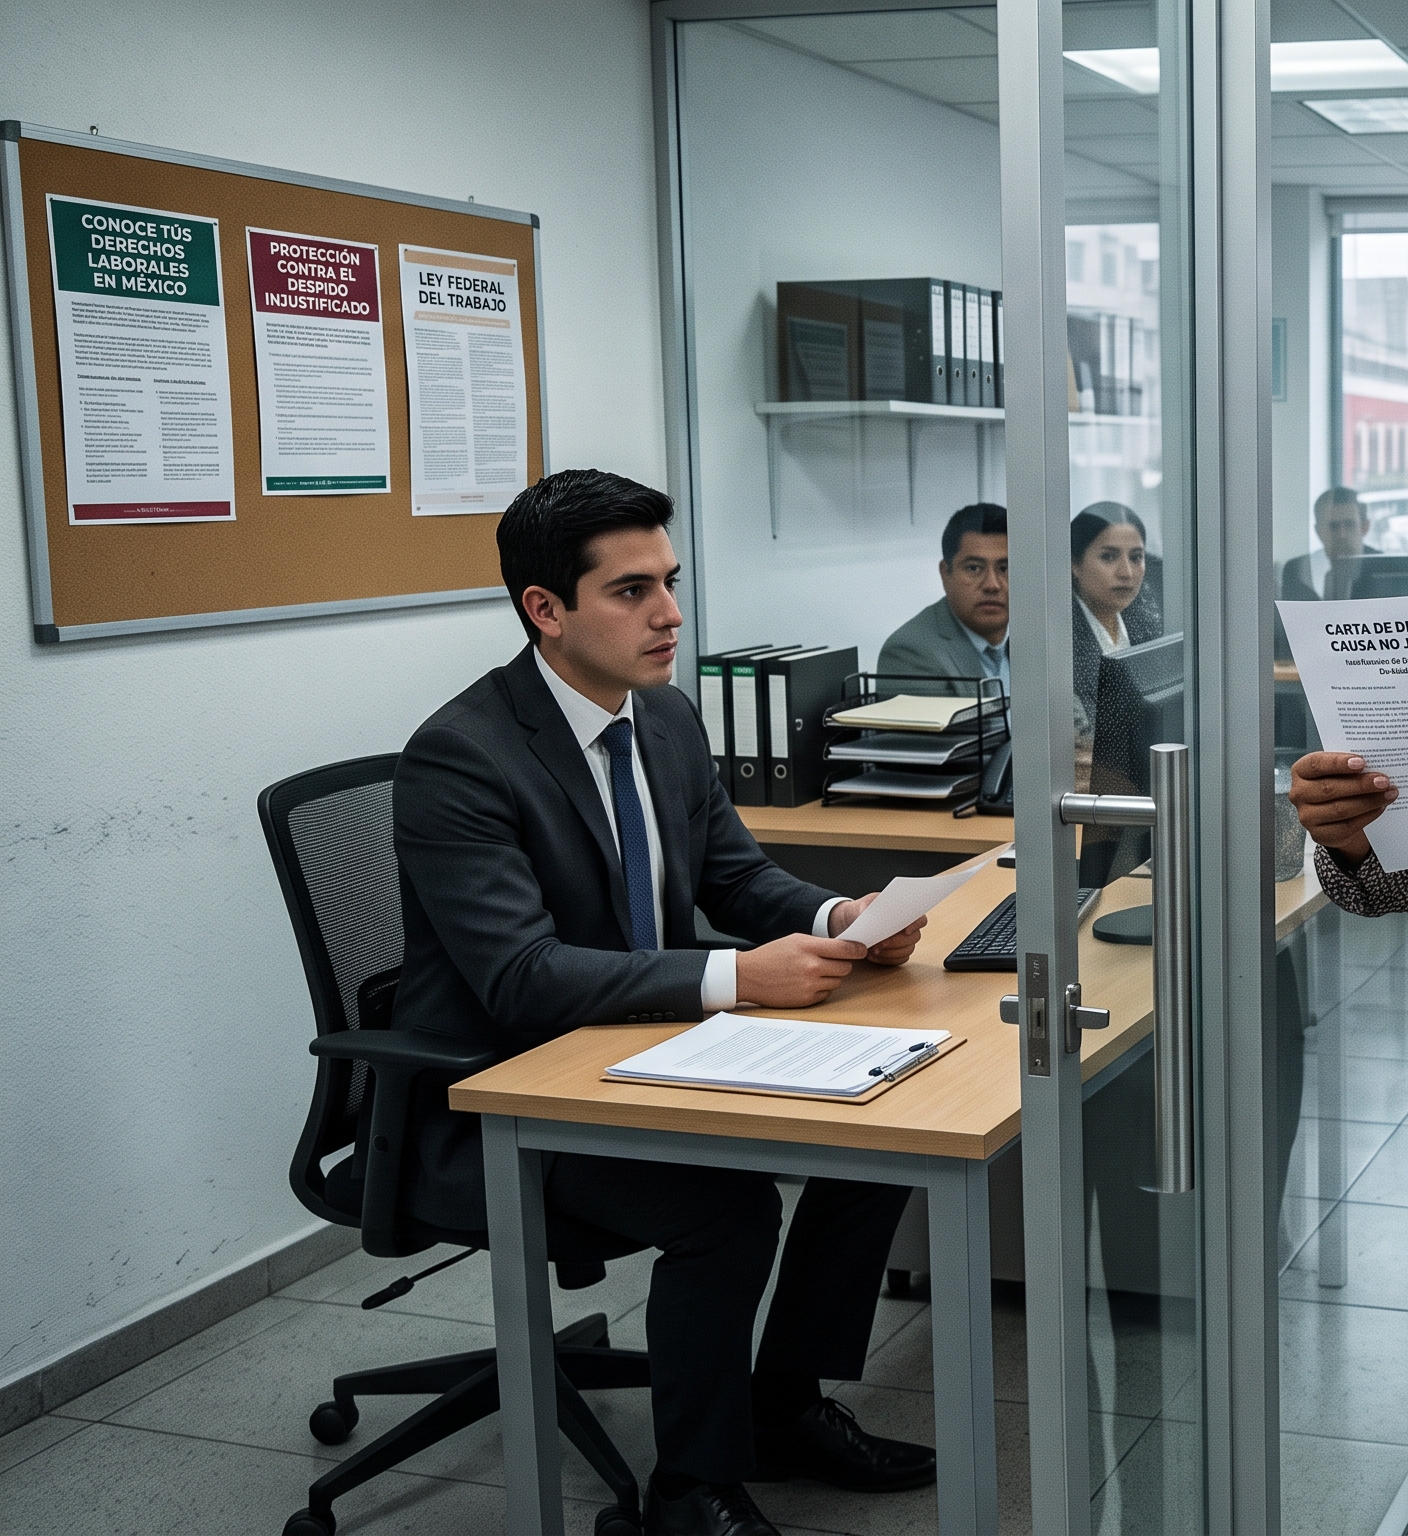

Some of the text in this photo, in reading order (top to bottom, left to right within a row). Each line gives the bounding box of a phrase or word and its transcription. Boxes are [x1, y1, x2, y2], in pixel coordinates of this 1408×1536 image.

[81, 213, 157, 237] CONOCE
[91, 233, 185, 259] DERECHOS
[270, 241, 360, 266] PROTECCIÓN
[87, 252, 189, 278] LABORALES
[277, 260, 356, 282] CONTRA EL
[93, 272, 187, 296] EN MÉXICO
[287, 278, 348, 297] DESPIDO
[419, 271, 505, 296] LEY FEDERAL
[265, 292, 370, 315] INJUSTIFICADO
[419, 290, 506, 312] DEL TRABAJO
[1325, 622, 1371, 636] CARTA
[1373, 621, 1393, 634] DE
[1330, 639, 1377, 652] CAUSA
[1379, 638, 1400, 651] NO
